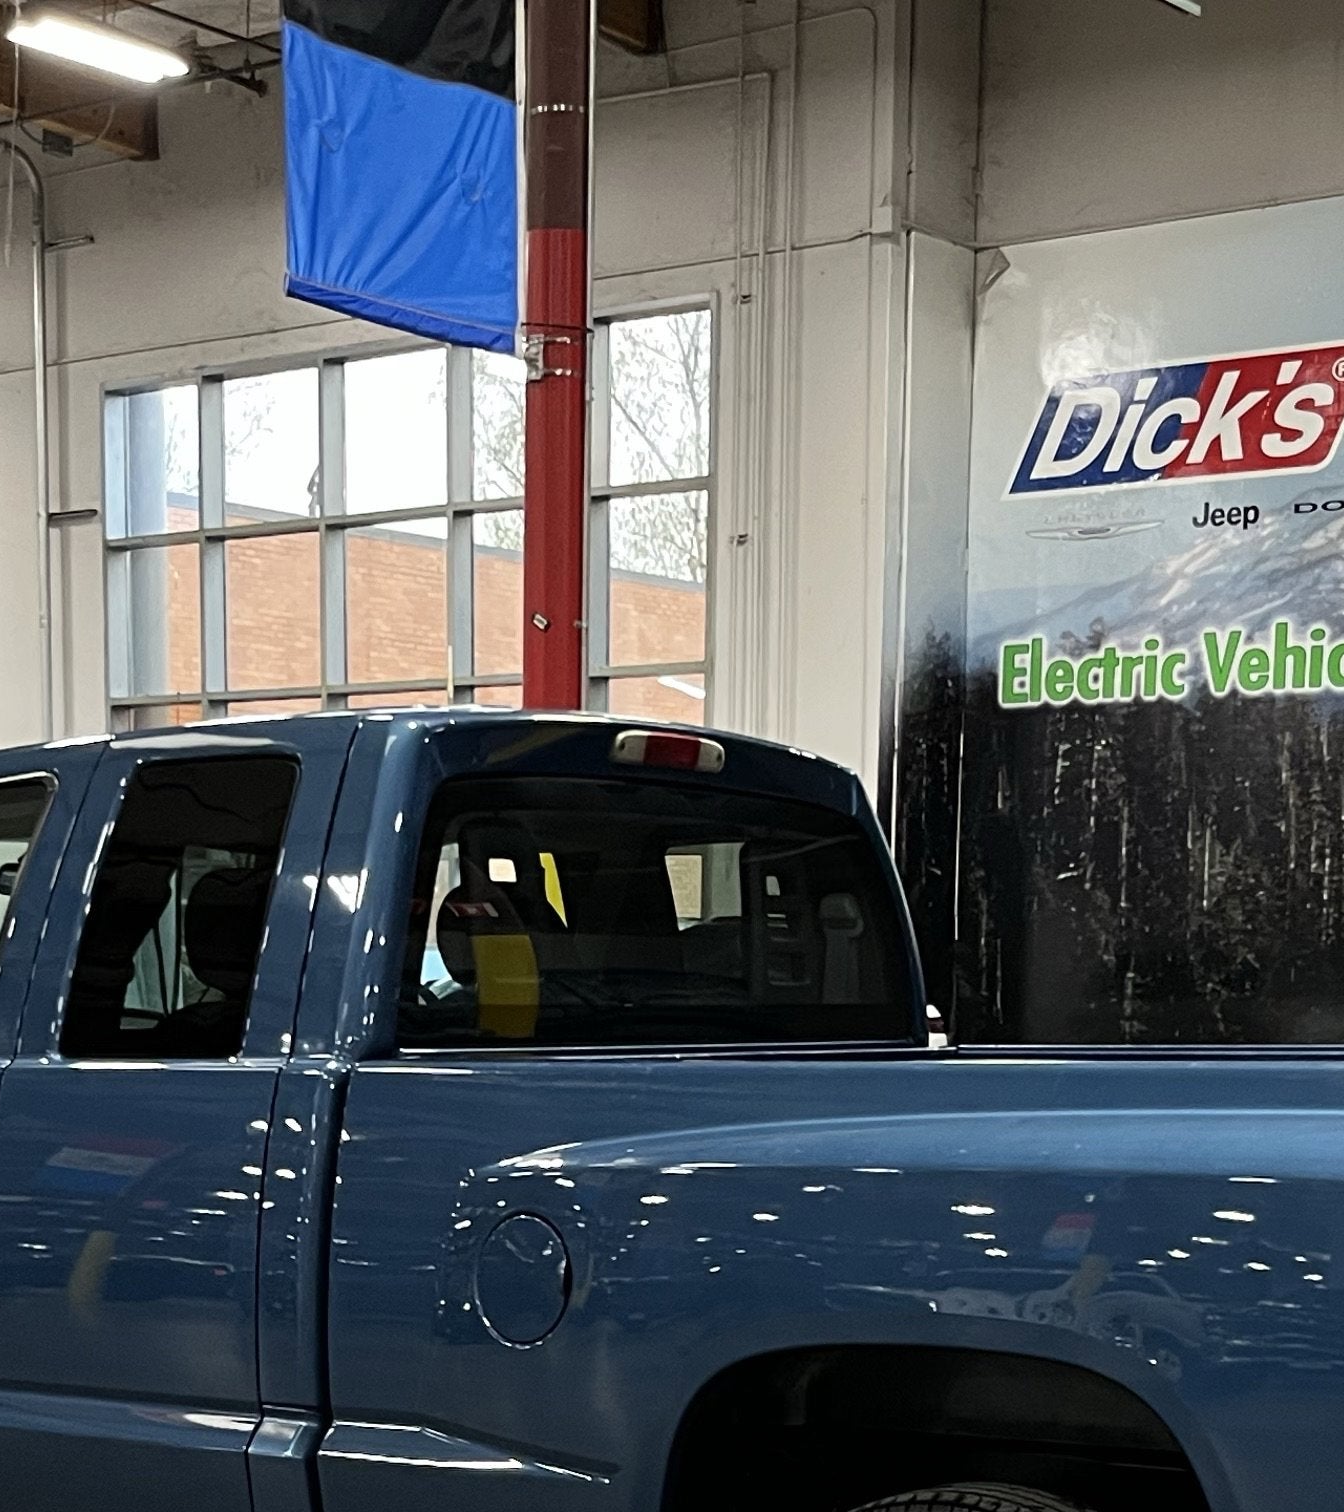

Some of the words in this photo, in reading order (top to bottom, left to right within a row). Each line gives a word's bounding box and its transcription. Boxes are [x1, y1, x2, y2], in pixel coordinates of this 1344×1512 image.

[1029, 361, 1334, 480] Dick's
[1192, 502, 1260, 530] Jeep
[1002, 638, 1186, 704] Electric
